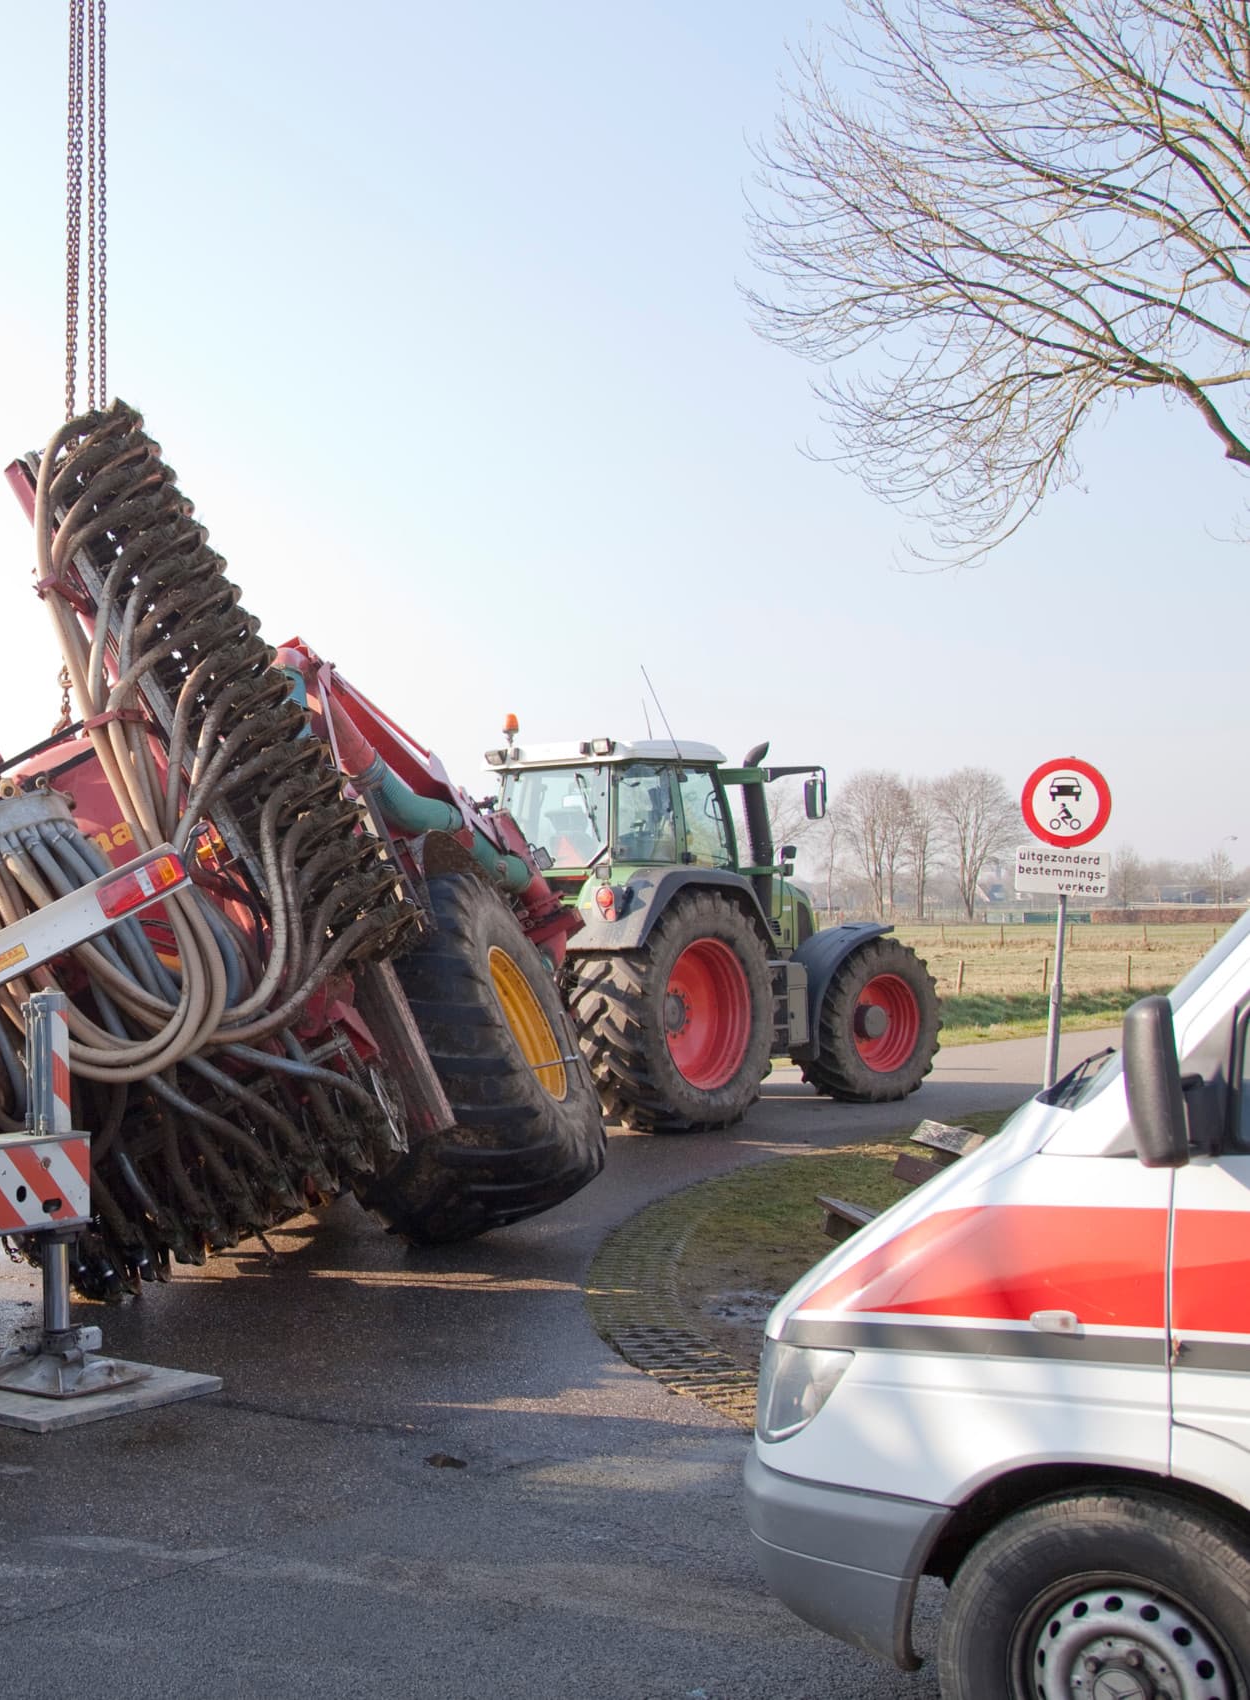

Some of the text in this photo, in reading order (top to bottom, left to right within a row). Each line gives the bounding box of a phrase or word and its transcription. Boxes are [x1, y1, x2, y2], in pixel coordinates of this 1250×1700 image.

[1018, 851, 1101, 865] uitgezonderd
[1018, 865, 1106, 881] bestemmings-
[1057, 883, 1106, 893] verkeer
